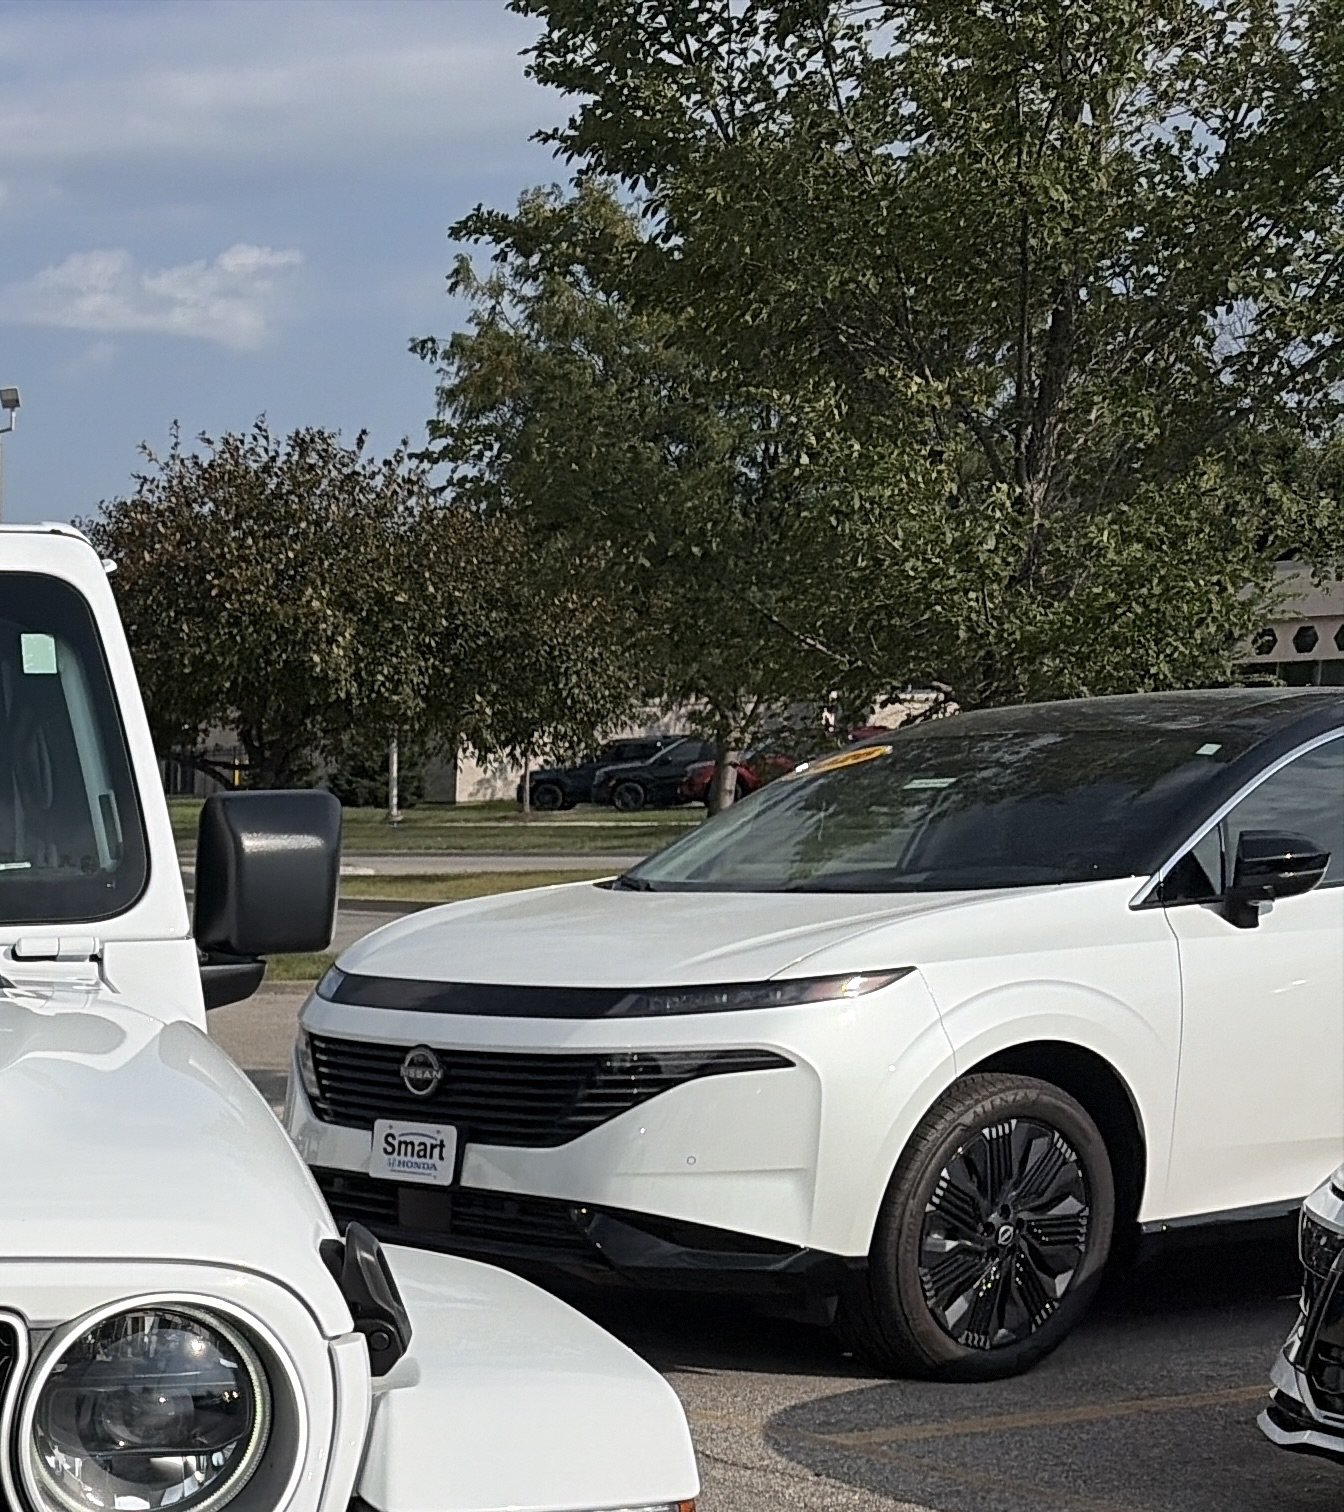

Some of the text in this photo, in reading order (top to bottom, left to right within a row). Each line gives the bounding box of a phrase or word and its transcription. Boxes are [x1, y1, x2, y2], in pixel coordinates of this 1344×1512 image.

[400, 1066, 443, 1080] NISSAN
[382, 1132, 446, 1162] Smart
[396, 1158, 438, 1171] HONDA
